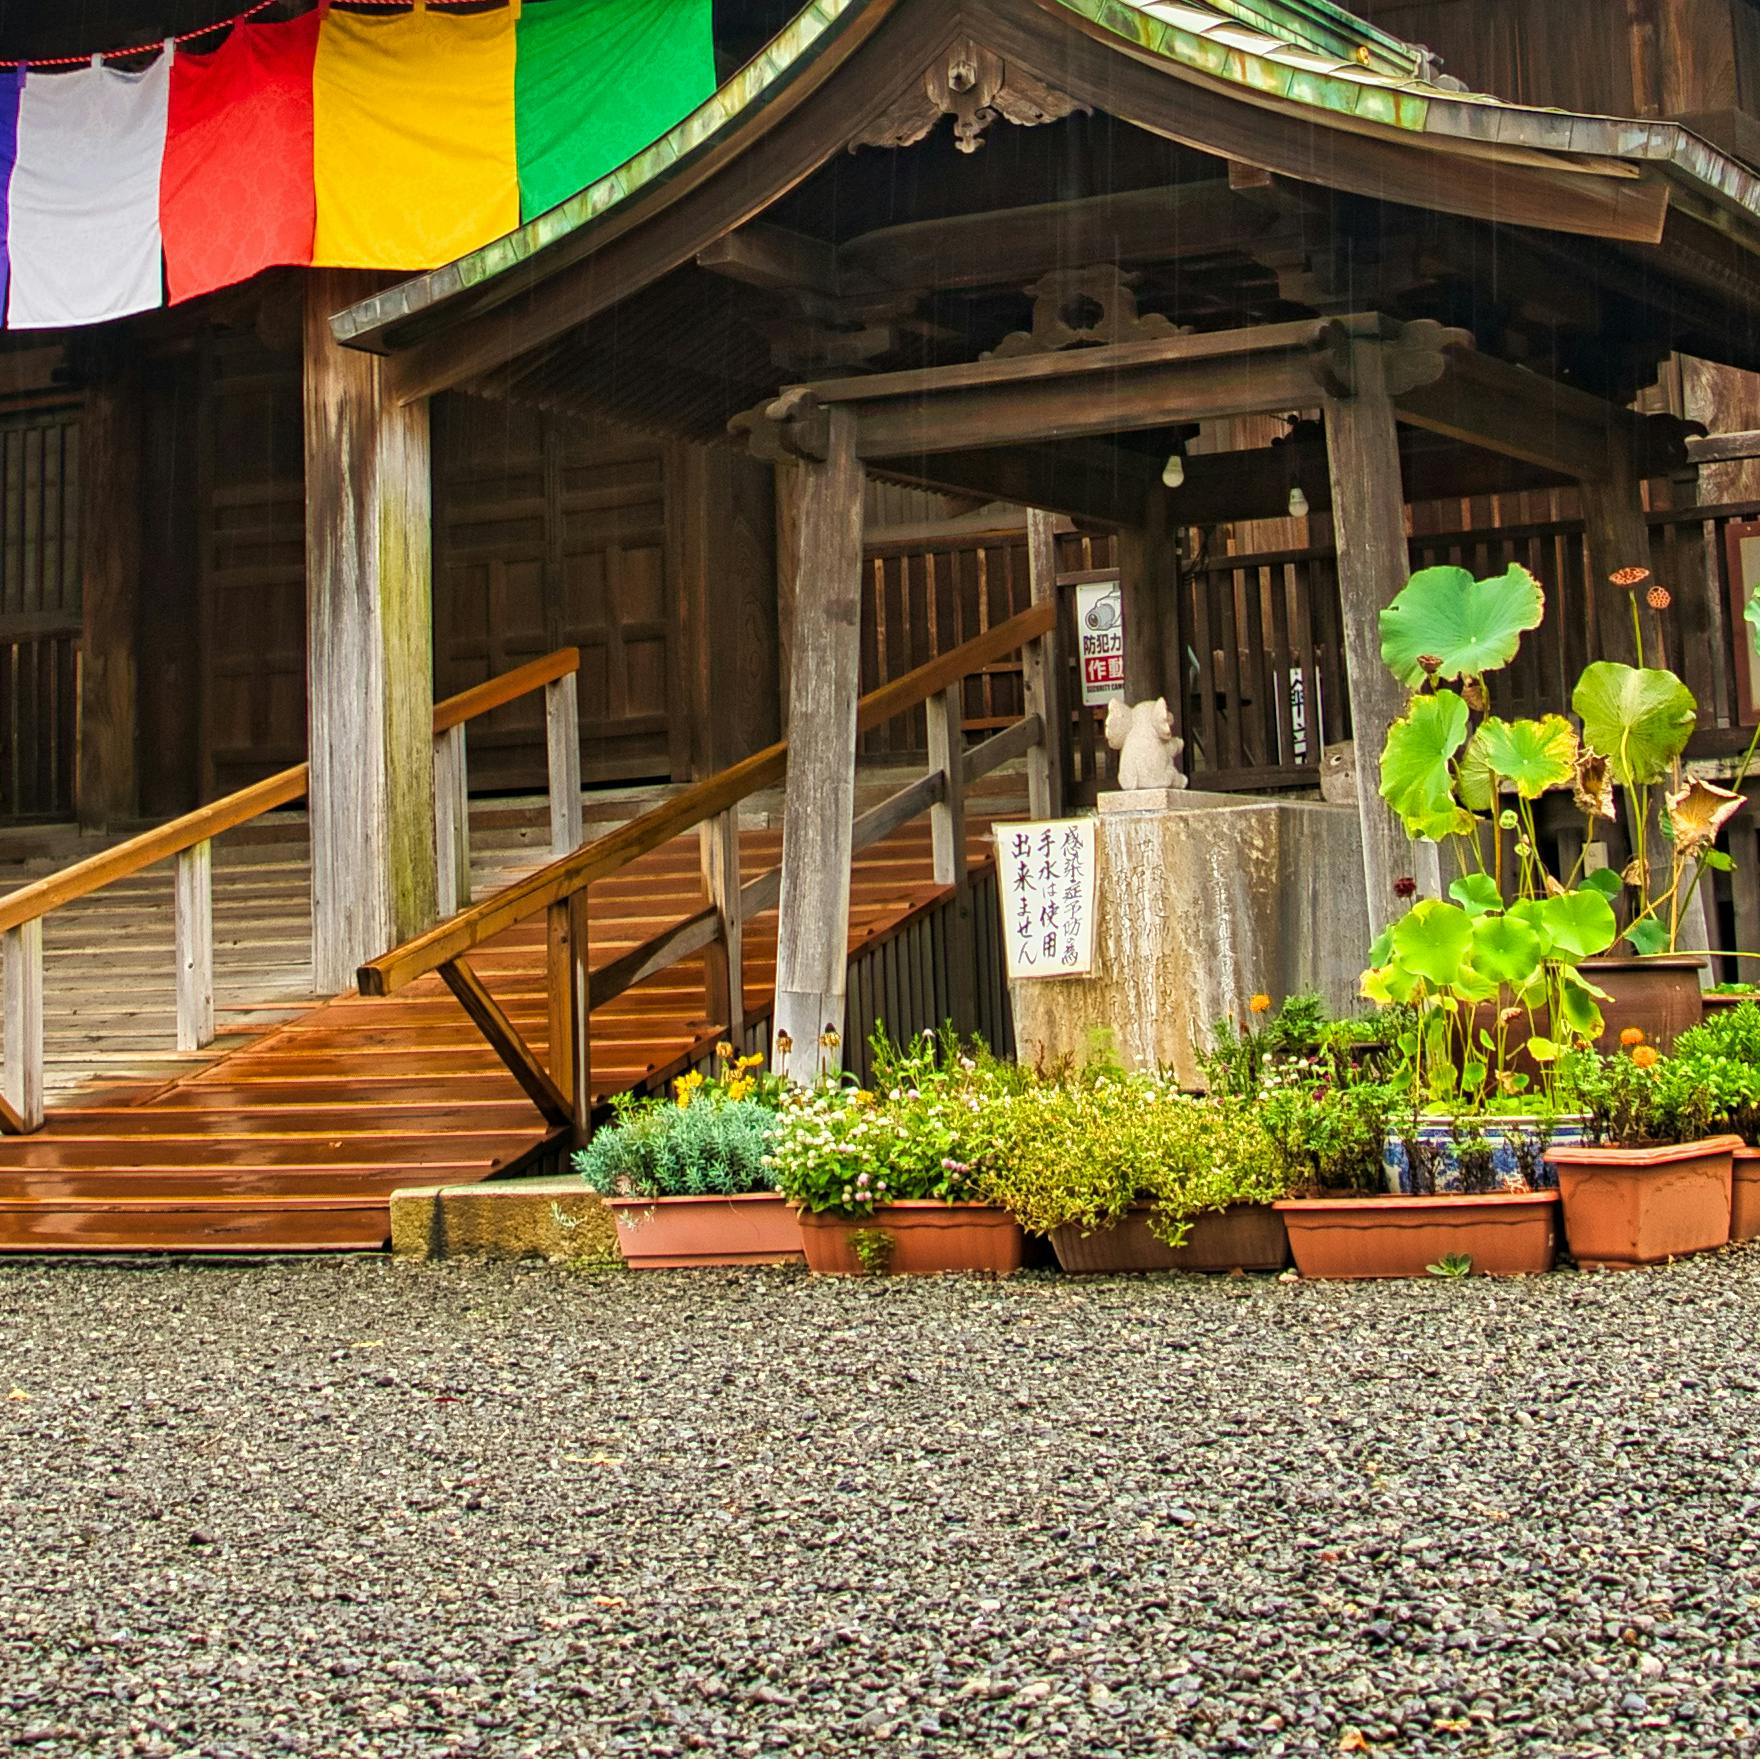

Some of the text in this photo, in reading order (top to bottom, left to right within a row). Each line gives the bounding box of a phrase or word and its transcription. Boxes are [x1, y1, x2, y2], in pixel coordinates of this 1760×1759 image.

[1011, 833, 1037, 966] 出来ません
[1037, 828, 1061, 959] 手水は使用
